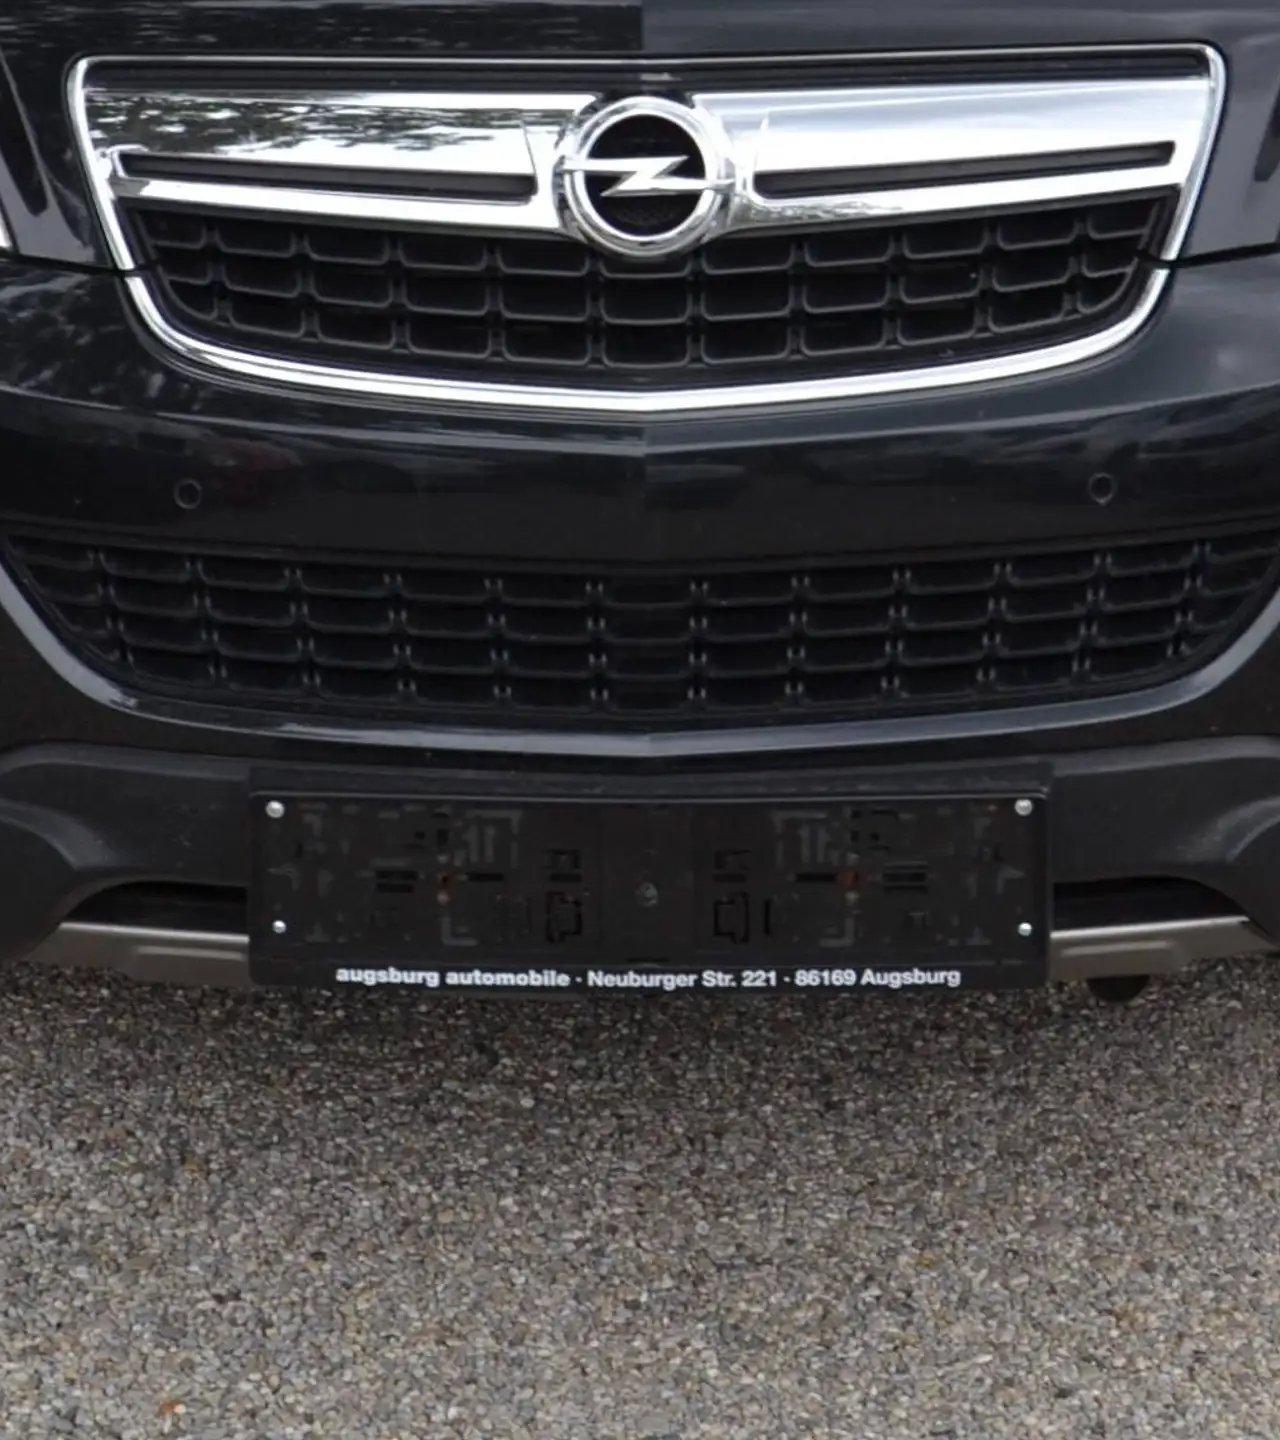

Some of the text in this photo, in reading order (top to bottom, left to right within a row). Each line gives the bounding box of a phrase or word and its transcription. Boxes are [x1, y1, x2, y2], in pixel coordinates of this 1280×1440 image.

[335, 966, 440, 988] augsburg
[445, 968, 571, 987] automobile
[587, 969, 698, 992] Neuburger
[701, 969, 738, 988] Str.
[741, 969, 777, 987] 221
[794, 968, 857, 987] 86169
[860, 967, 962, 990] Augsburg
